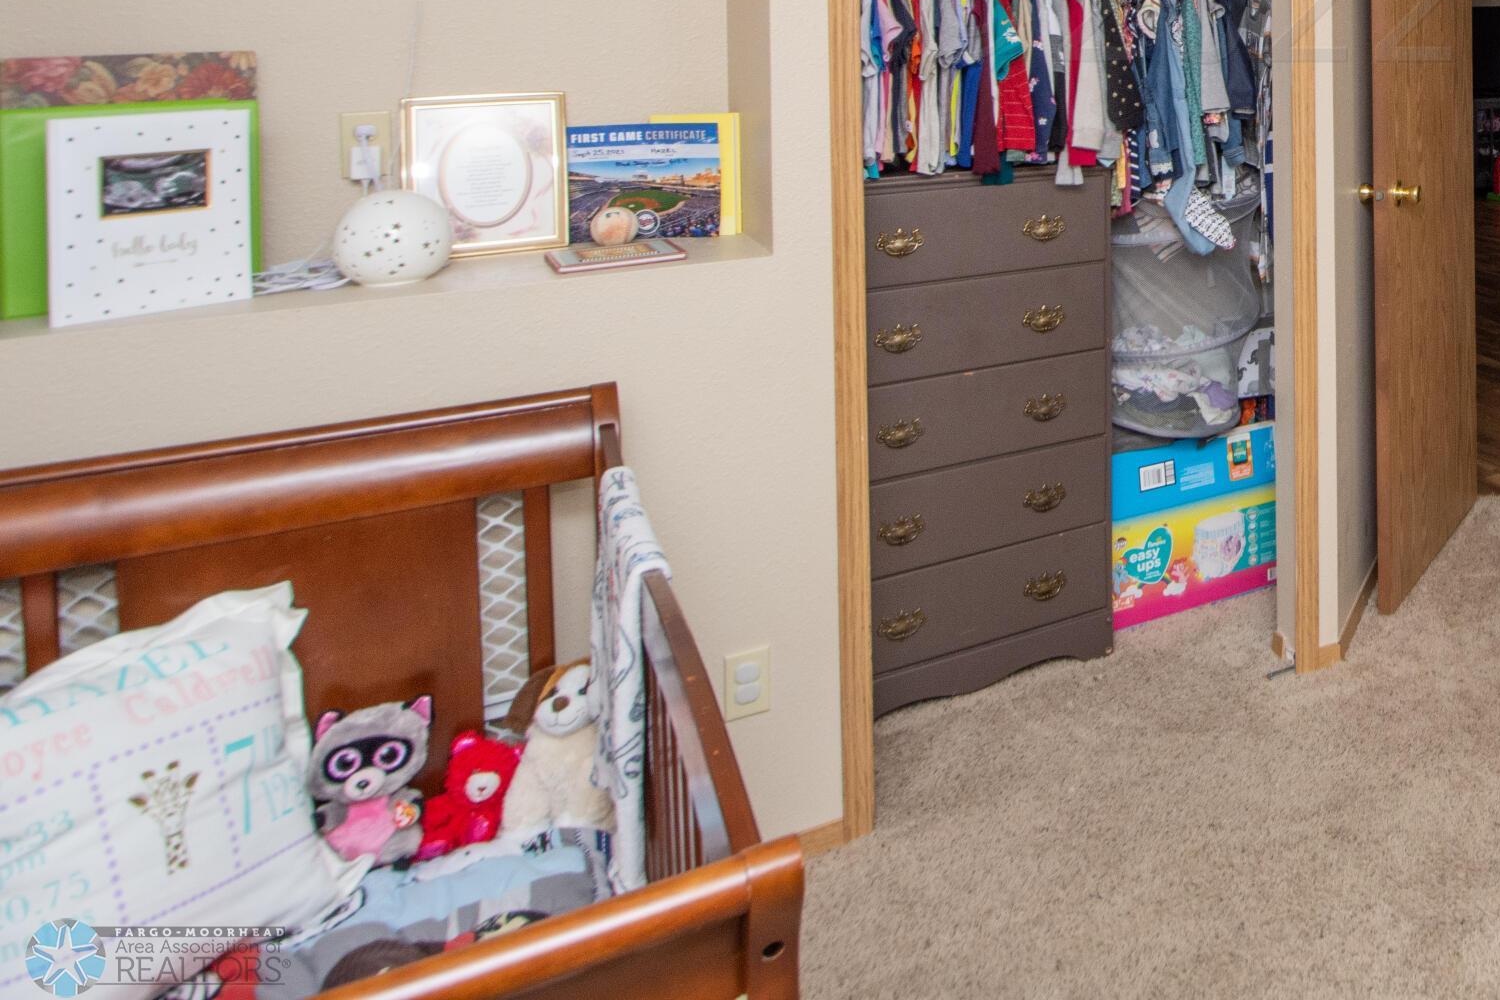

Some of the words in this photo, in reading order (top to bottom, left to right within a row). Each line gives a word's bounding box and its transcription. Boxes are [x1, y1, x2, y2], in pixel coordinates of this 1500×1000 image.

[570, 132, 605, 144] FIRST
[609, 131, 643, 142] GAME
[645, 129, 706, 141] CERTIFICATE
[1129, 547, 1161, 564] easy
[1137, 557, 1162, 576] ups
[2, 722, 94, 783] oyce
